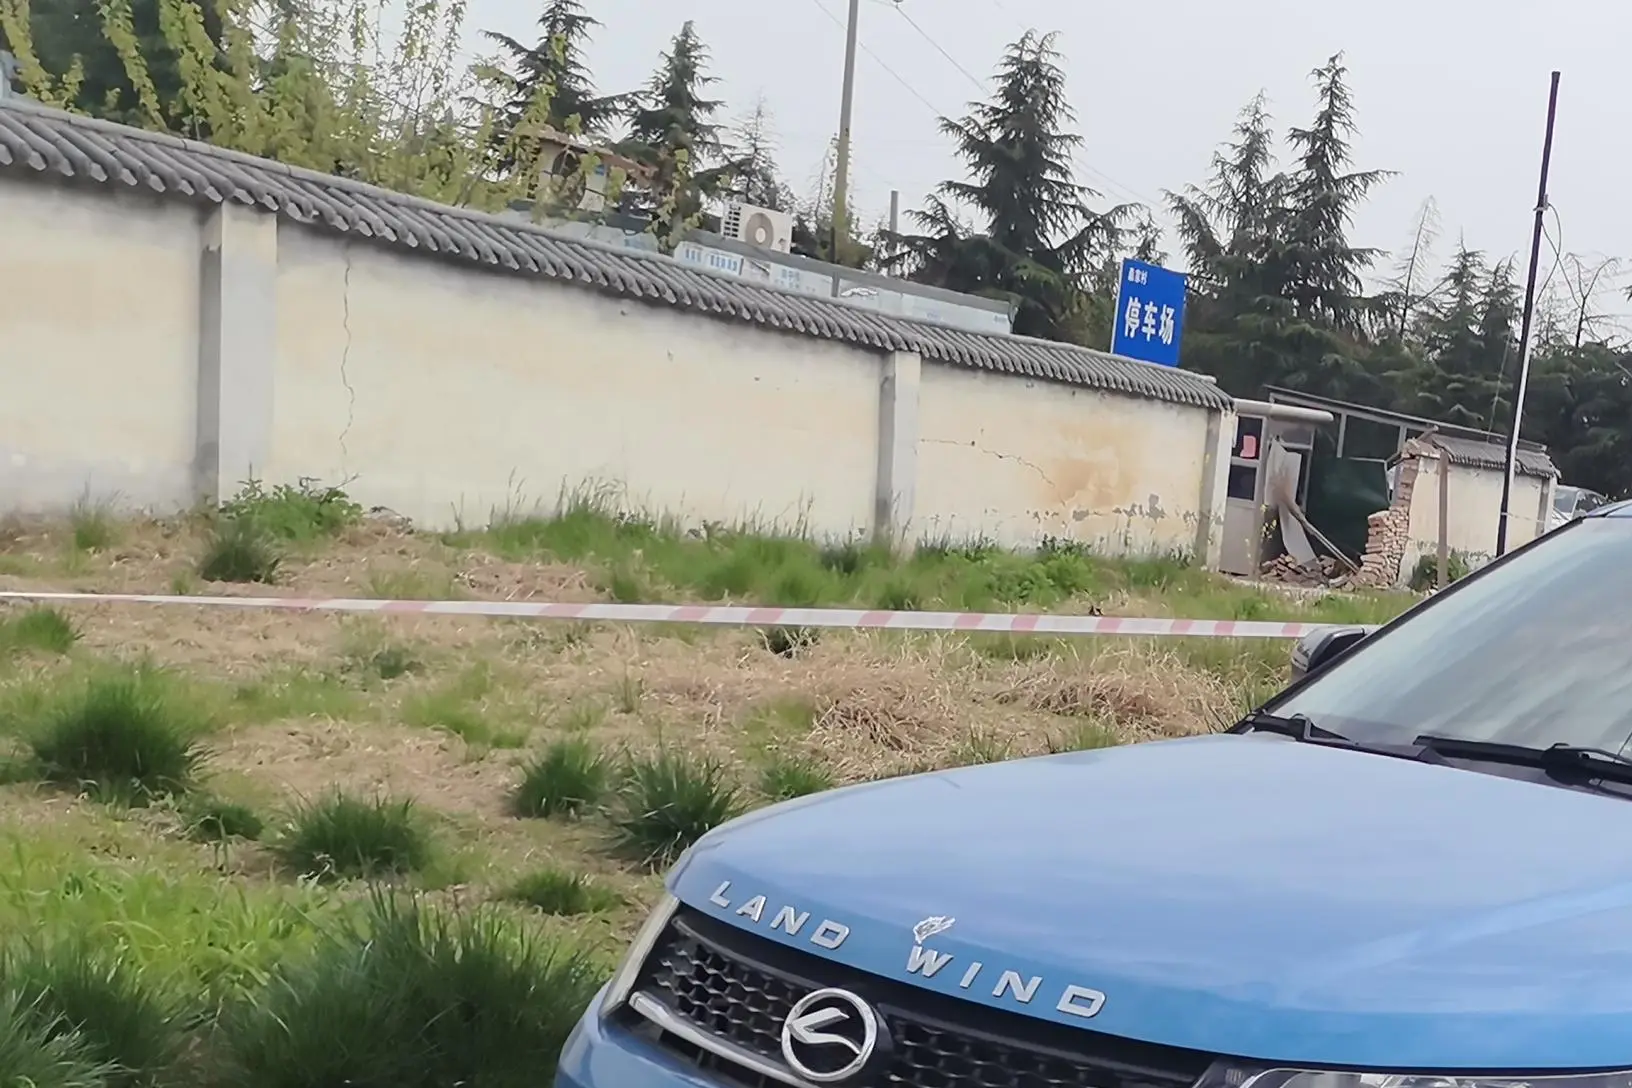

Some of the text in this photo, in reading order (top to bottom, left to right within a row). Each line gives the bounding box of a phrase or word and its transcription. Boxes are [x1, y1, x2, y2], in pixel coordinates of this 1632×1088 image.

[1124, 296, 1175, 345] 停车场
[709, 880, 1107, 1018] LAND WIND
